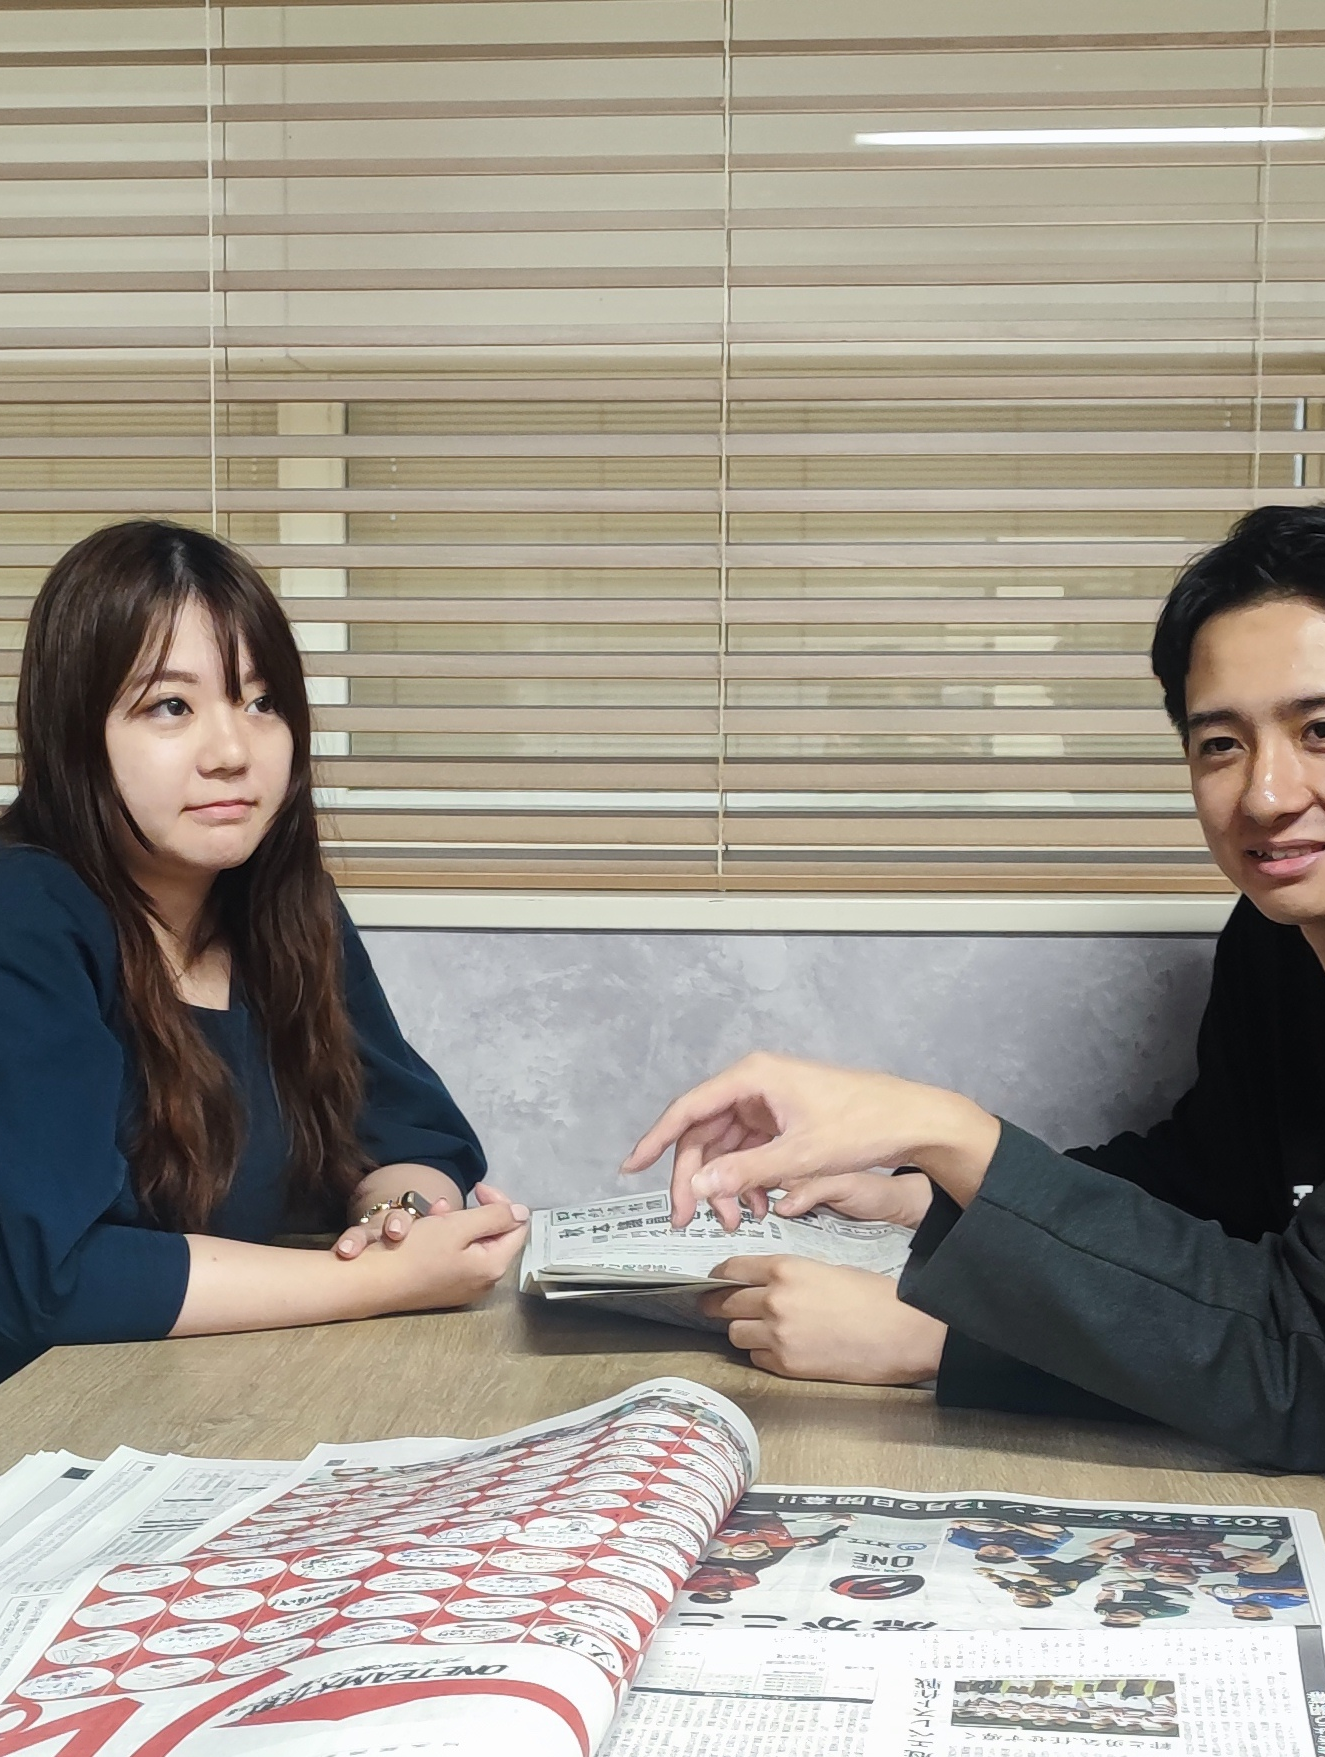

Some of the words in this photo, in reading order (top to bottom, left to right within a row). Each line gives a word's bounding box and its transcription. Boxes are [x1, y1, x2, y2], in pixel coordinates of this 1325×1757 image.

[777, 1494, 989, 1513] 12月9日開幕!!
[1000, 1503, 1281, 1528] 2023-24シーズン
[852, 1552, 914, 1567] ONE
